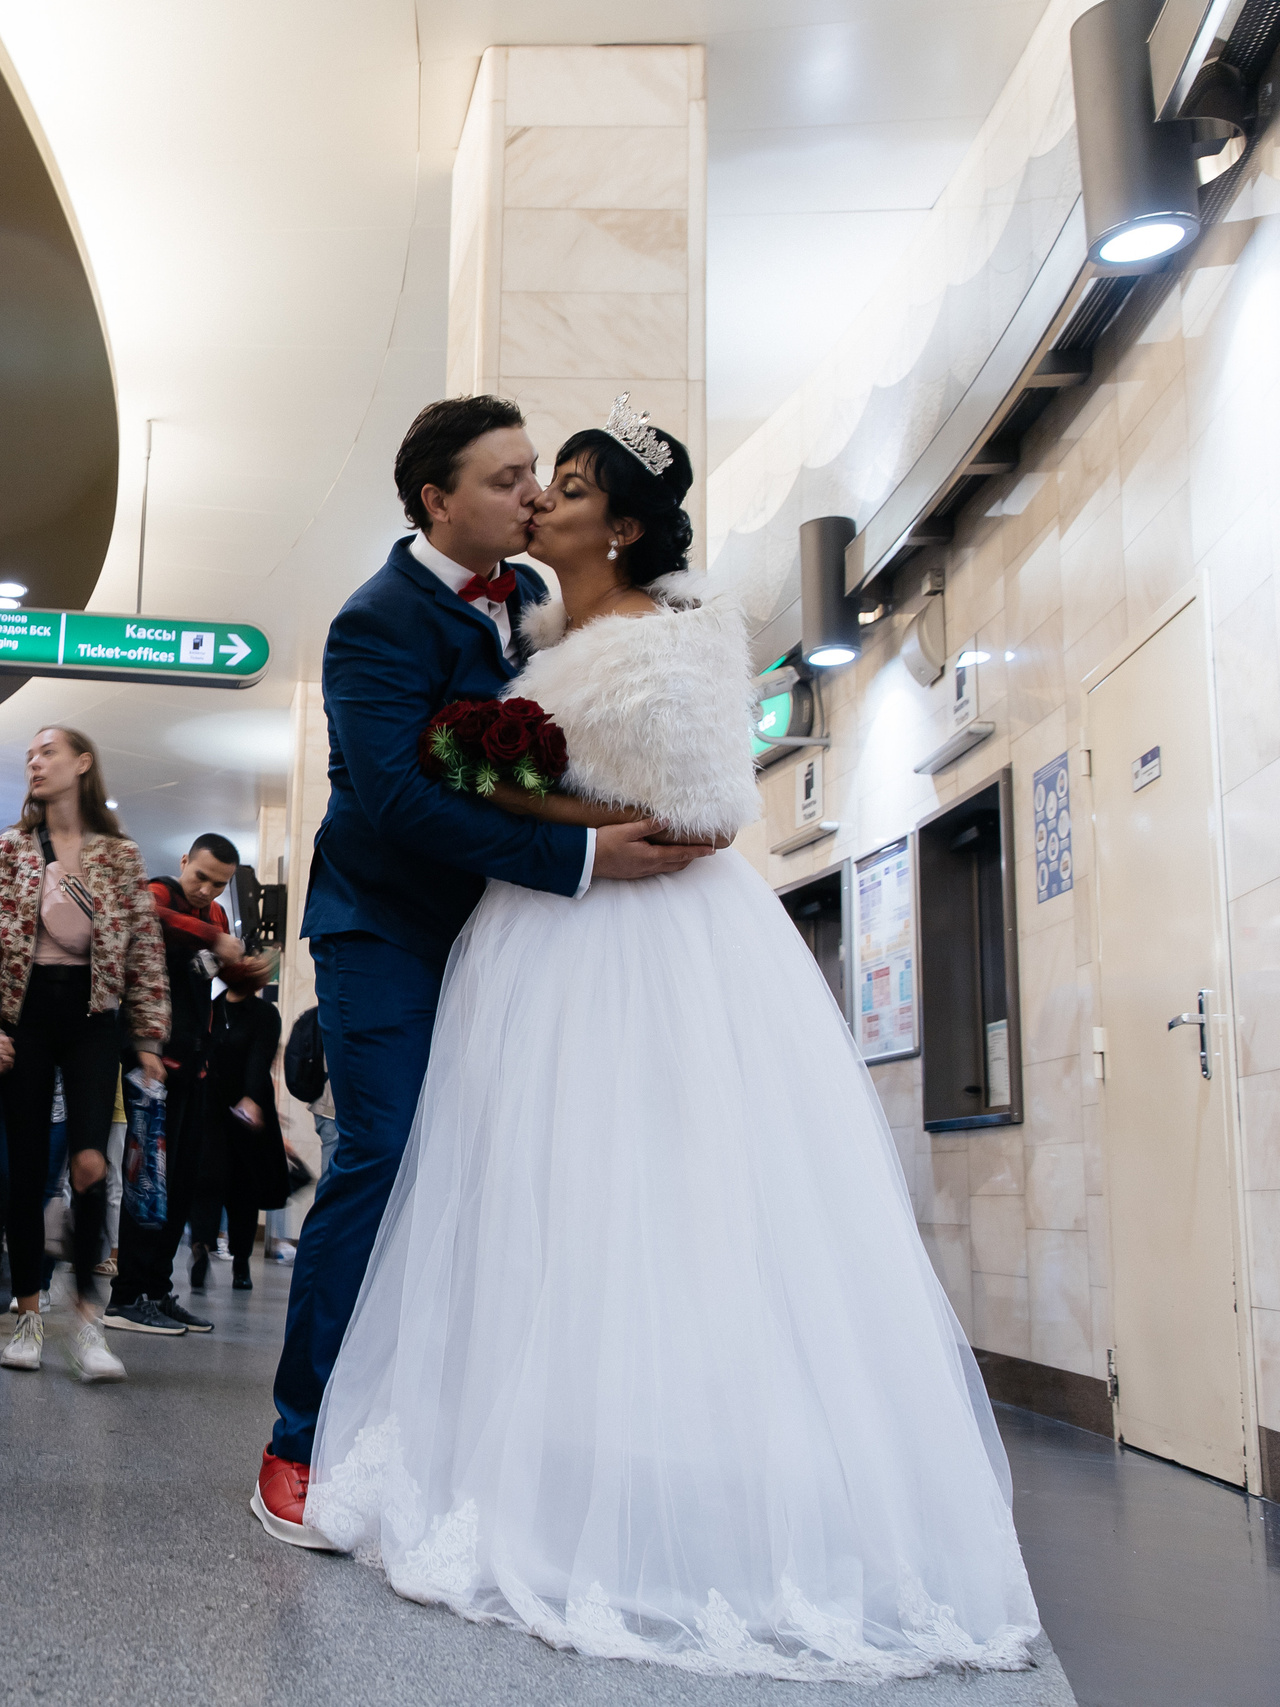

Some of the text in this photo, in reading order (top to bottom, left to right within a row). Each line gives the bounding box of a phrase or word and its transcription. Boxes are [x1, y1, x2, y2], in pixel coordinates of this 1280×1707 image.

[29, 625, 51, 637] БСК
[125, 623, 175, 640] Кассы
[77, 643, 175, 662] Ticket-offices
